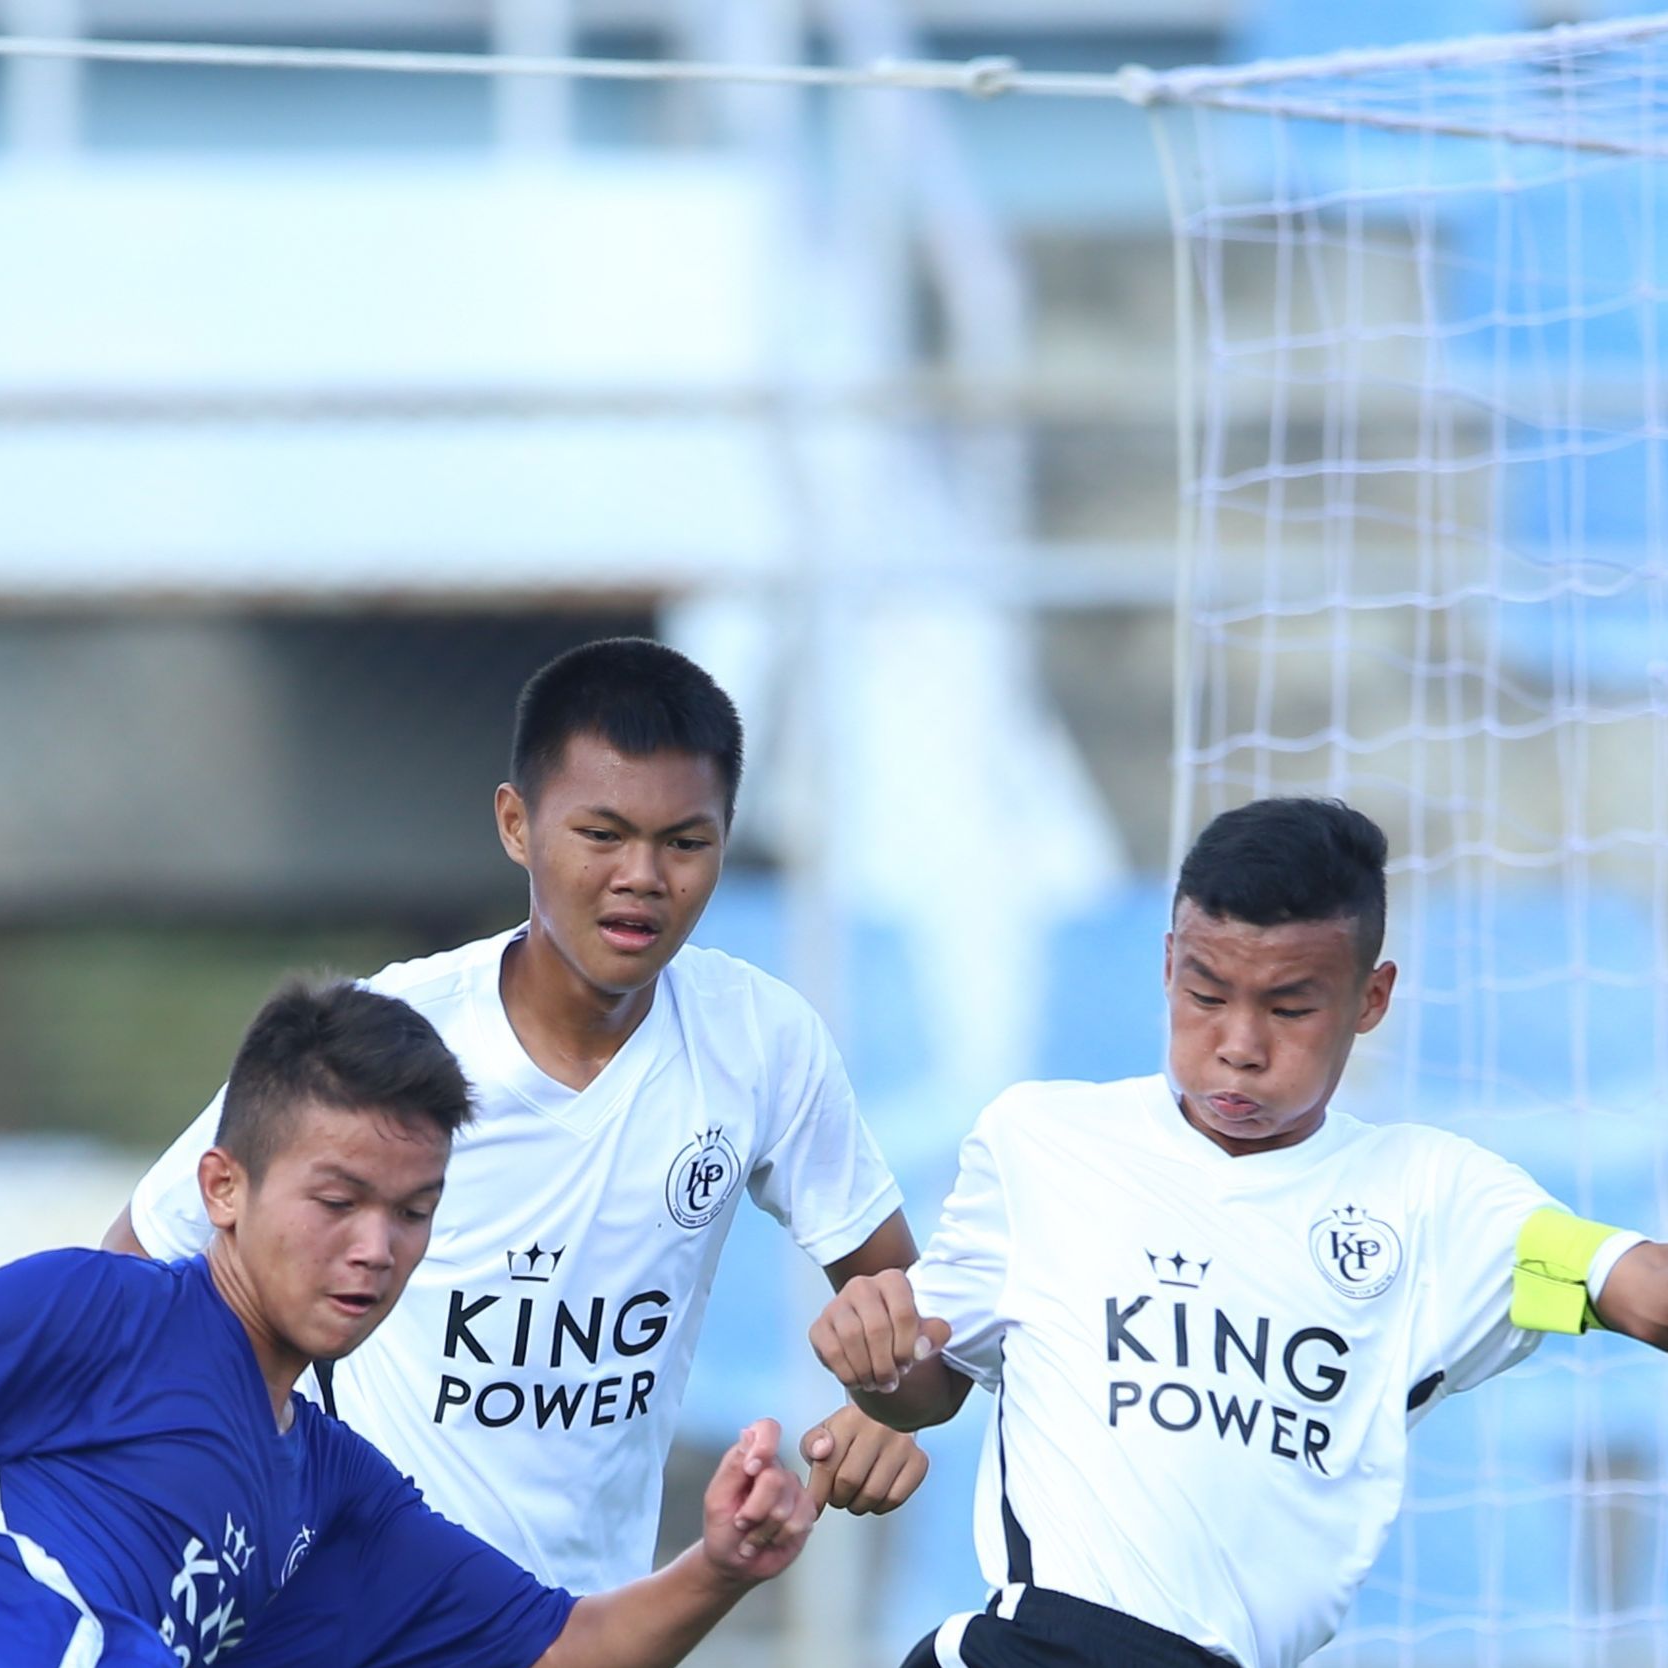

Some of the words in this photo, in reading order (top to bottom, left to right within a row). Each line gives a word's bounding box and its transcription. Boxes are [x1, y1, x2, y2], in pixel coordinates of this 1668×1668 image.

[443, 1289, 672, 1368] KING
[1105, 1294, 1350, 1402] KING
[433, 1369, 656, 1430] POWER
[1108, 1380, 1331, 1476] POWER
